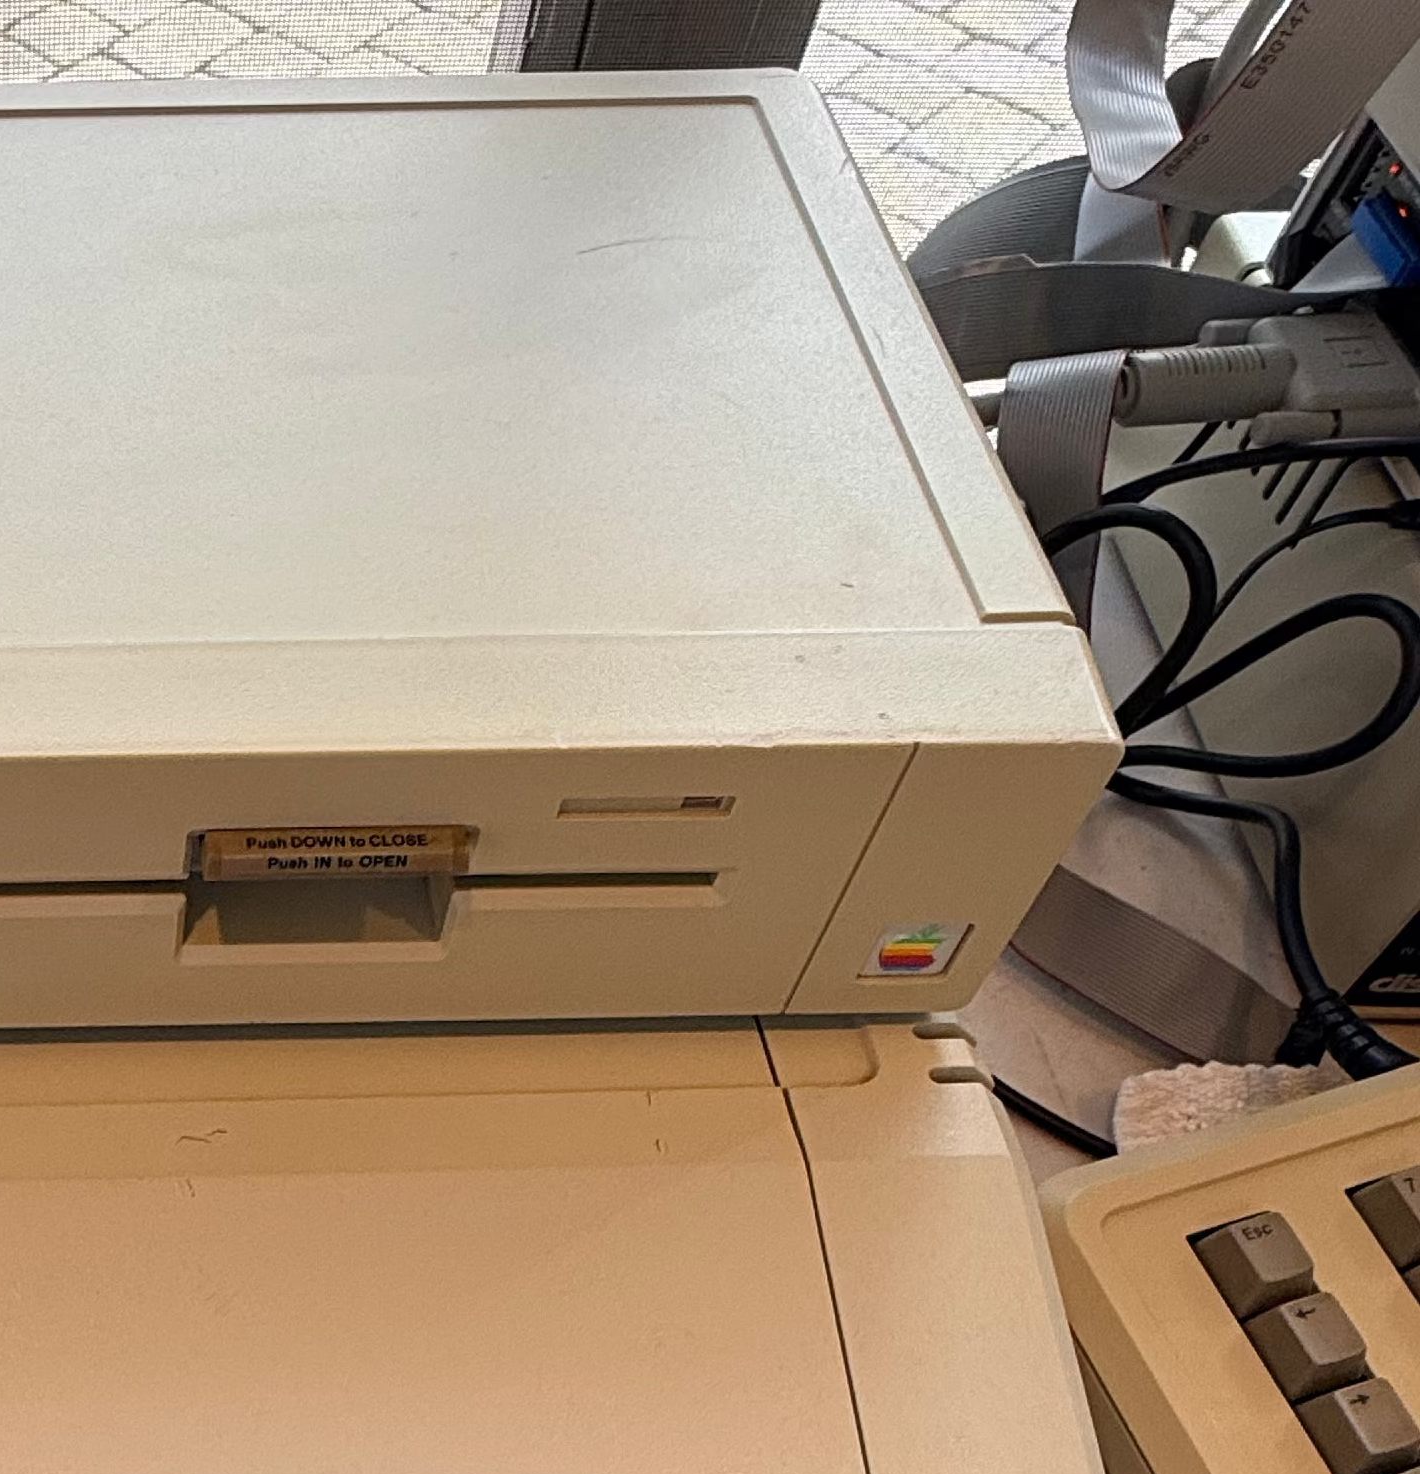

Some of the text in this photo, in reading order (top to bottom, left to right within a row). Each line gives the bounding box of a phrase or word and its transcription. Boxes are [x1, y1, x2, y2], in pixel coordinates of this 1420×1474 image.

[1240, 1, 1311, 90] E350147
[246, 834, 429, 849] Push DOWN to CLOSE
[267, 855, 408, 869] Push IN to OPEN
[1404, 1177, 1416, 1193] 7
[1242, 1224, 1274, 1241] Esc
